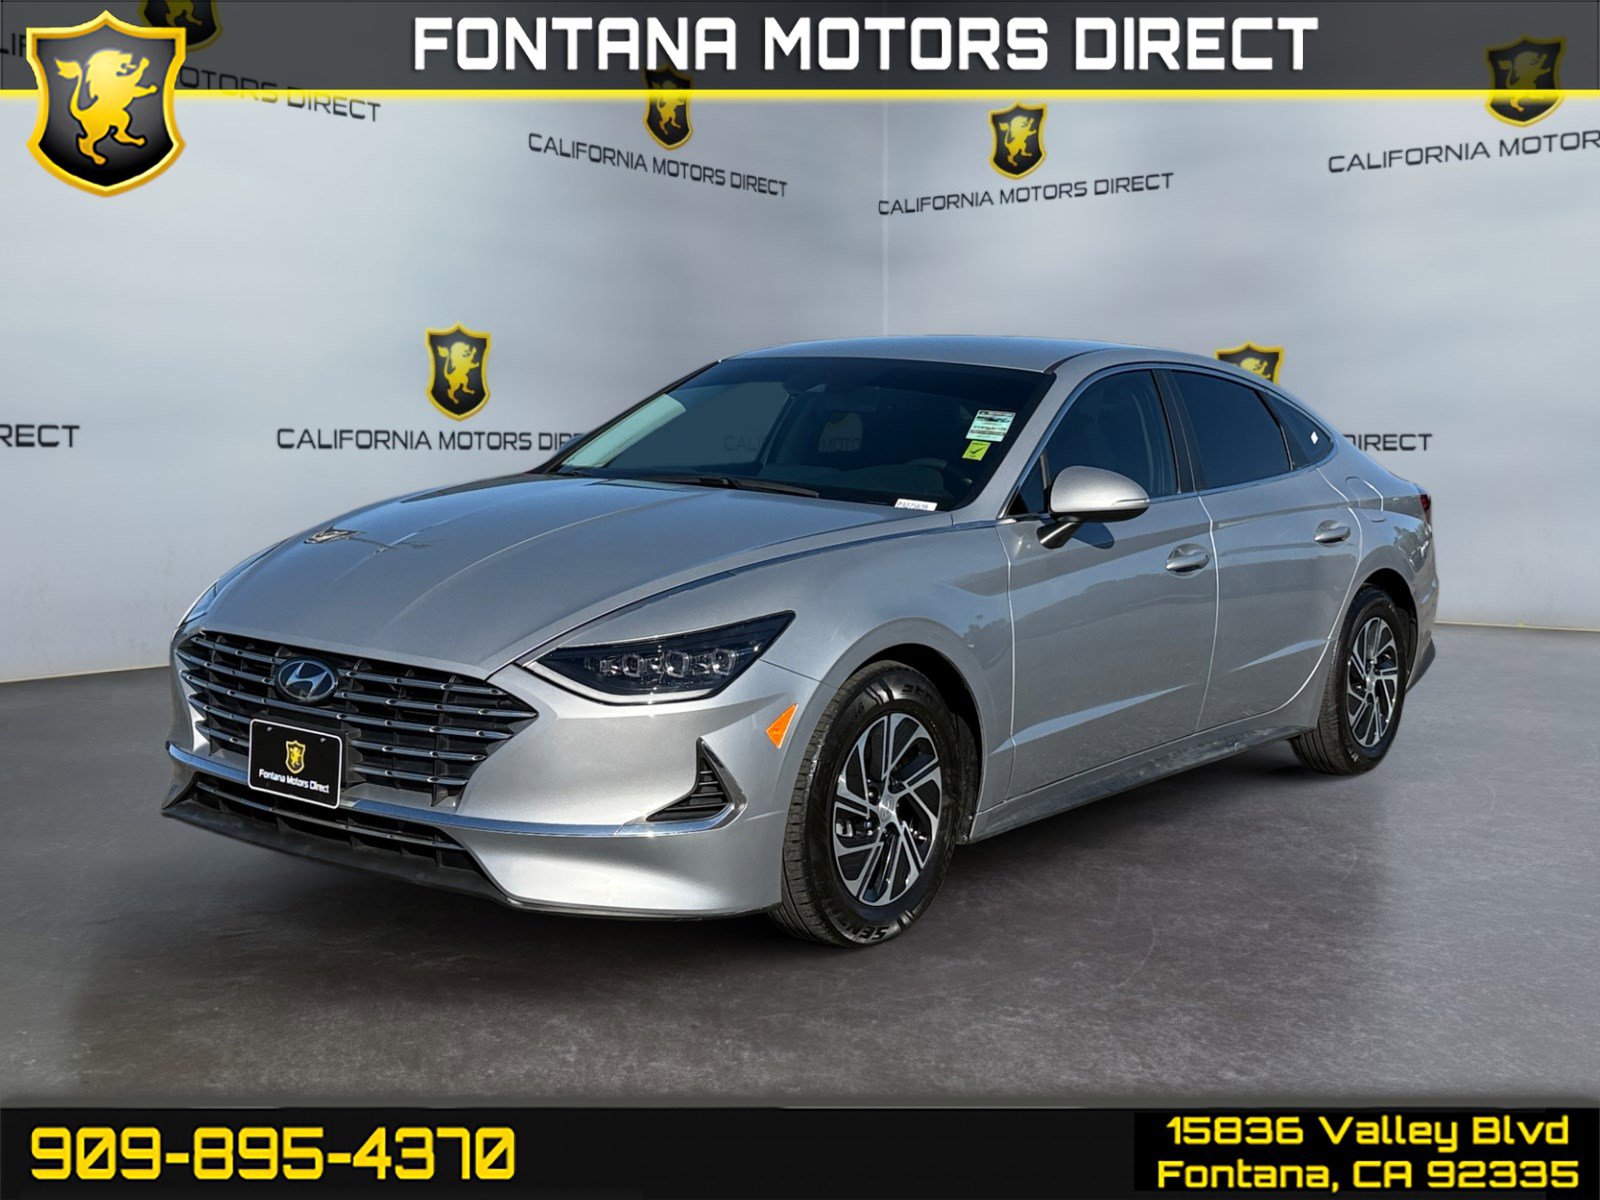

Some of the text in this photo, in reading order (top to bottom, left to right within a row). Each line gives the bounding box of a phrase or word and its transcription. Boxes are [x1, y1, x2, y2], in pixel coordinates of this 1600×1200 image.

[179, 66, 381, 122] OTORS DIRECT
[528, 133, 788, 197] CALIFORNIA MOTORS DIRECT
[1328, 130, 1600, 173] CALIFORNIA MOTOR
[878, 173, 1174, 215] CALIFORNIA MOTORS DIRECT
[0, 424, 80, 448] RECT
[276, 428, 432, 449] CALIFORNIA
[438, 431, 532, 450] MOTORS
[258, 768, 330, 794] Fontana Motors Direct
